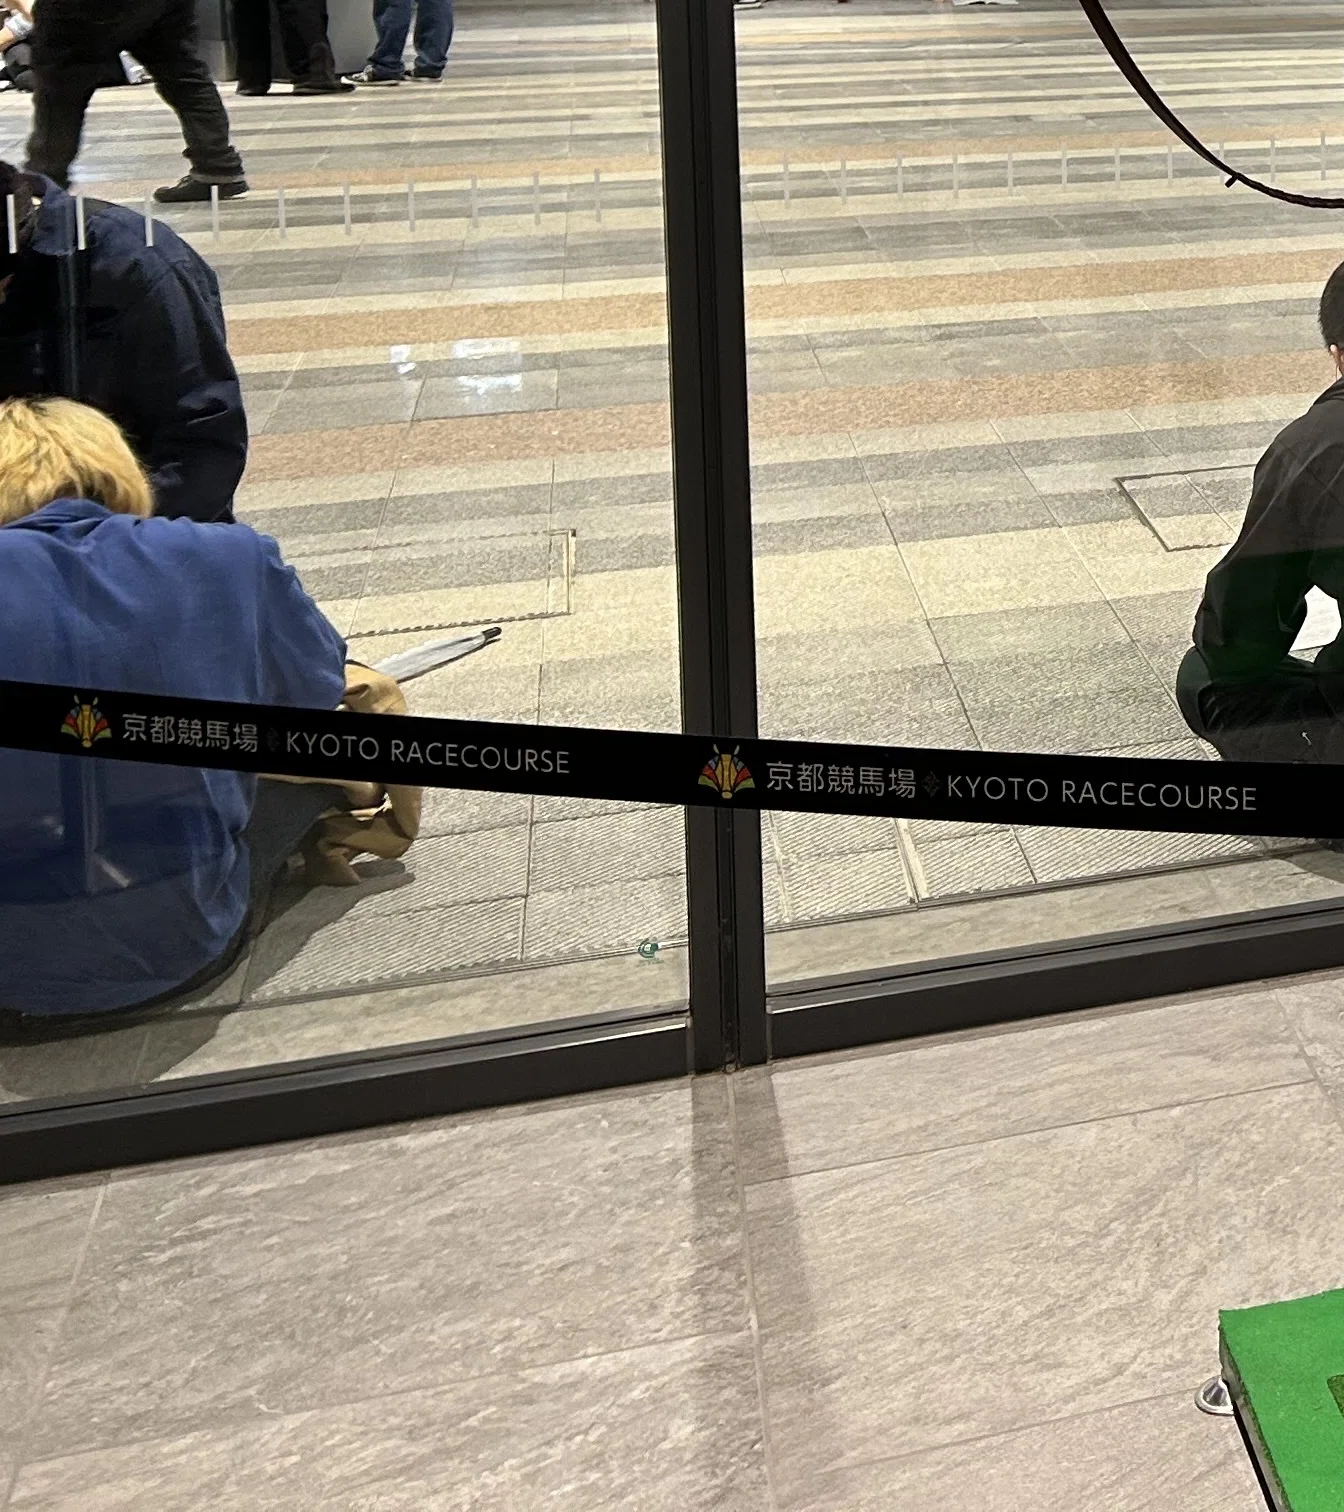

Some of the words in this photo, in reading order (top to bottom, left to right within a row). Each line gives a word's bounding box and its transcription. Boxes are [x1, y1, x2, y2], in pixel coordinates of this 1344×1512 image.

[121, 712, 259, 753] 京都競馬場
[286, 731, 380, 760] KYOTO
[390, 740, 571, 775] RACECOURSE
[766, 760, 917, 799] 京都競馬場
[947, 775, 1049, 802] KYOTO
[1061, 779, 1258, 812] RACECOURSE
